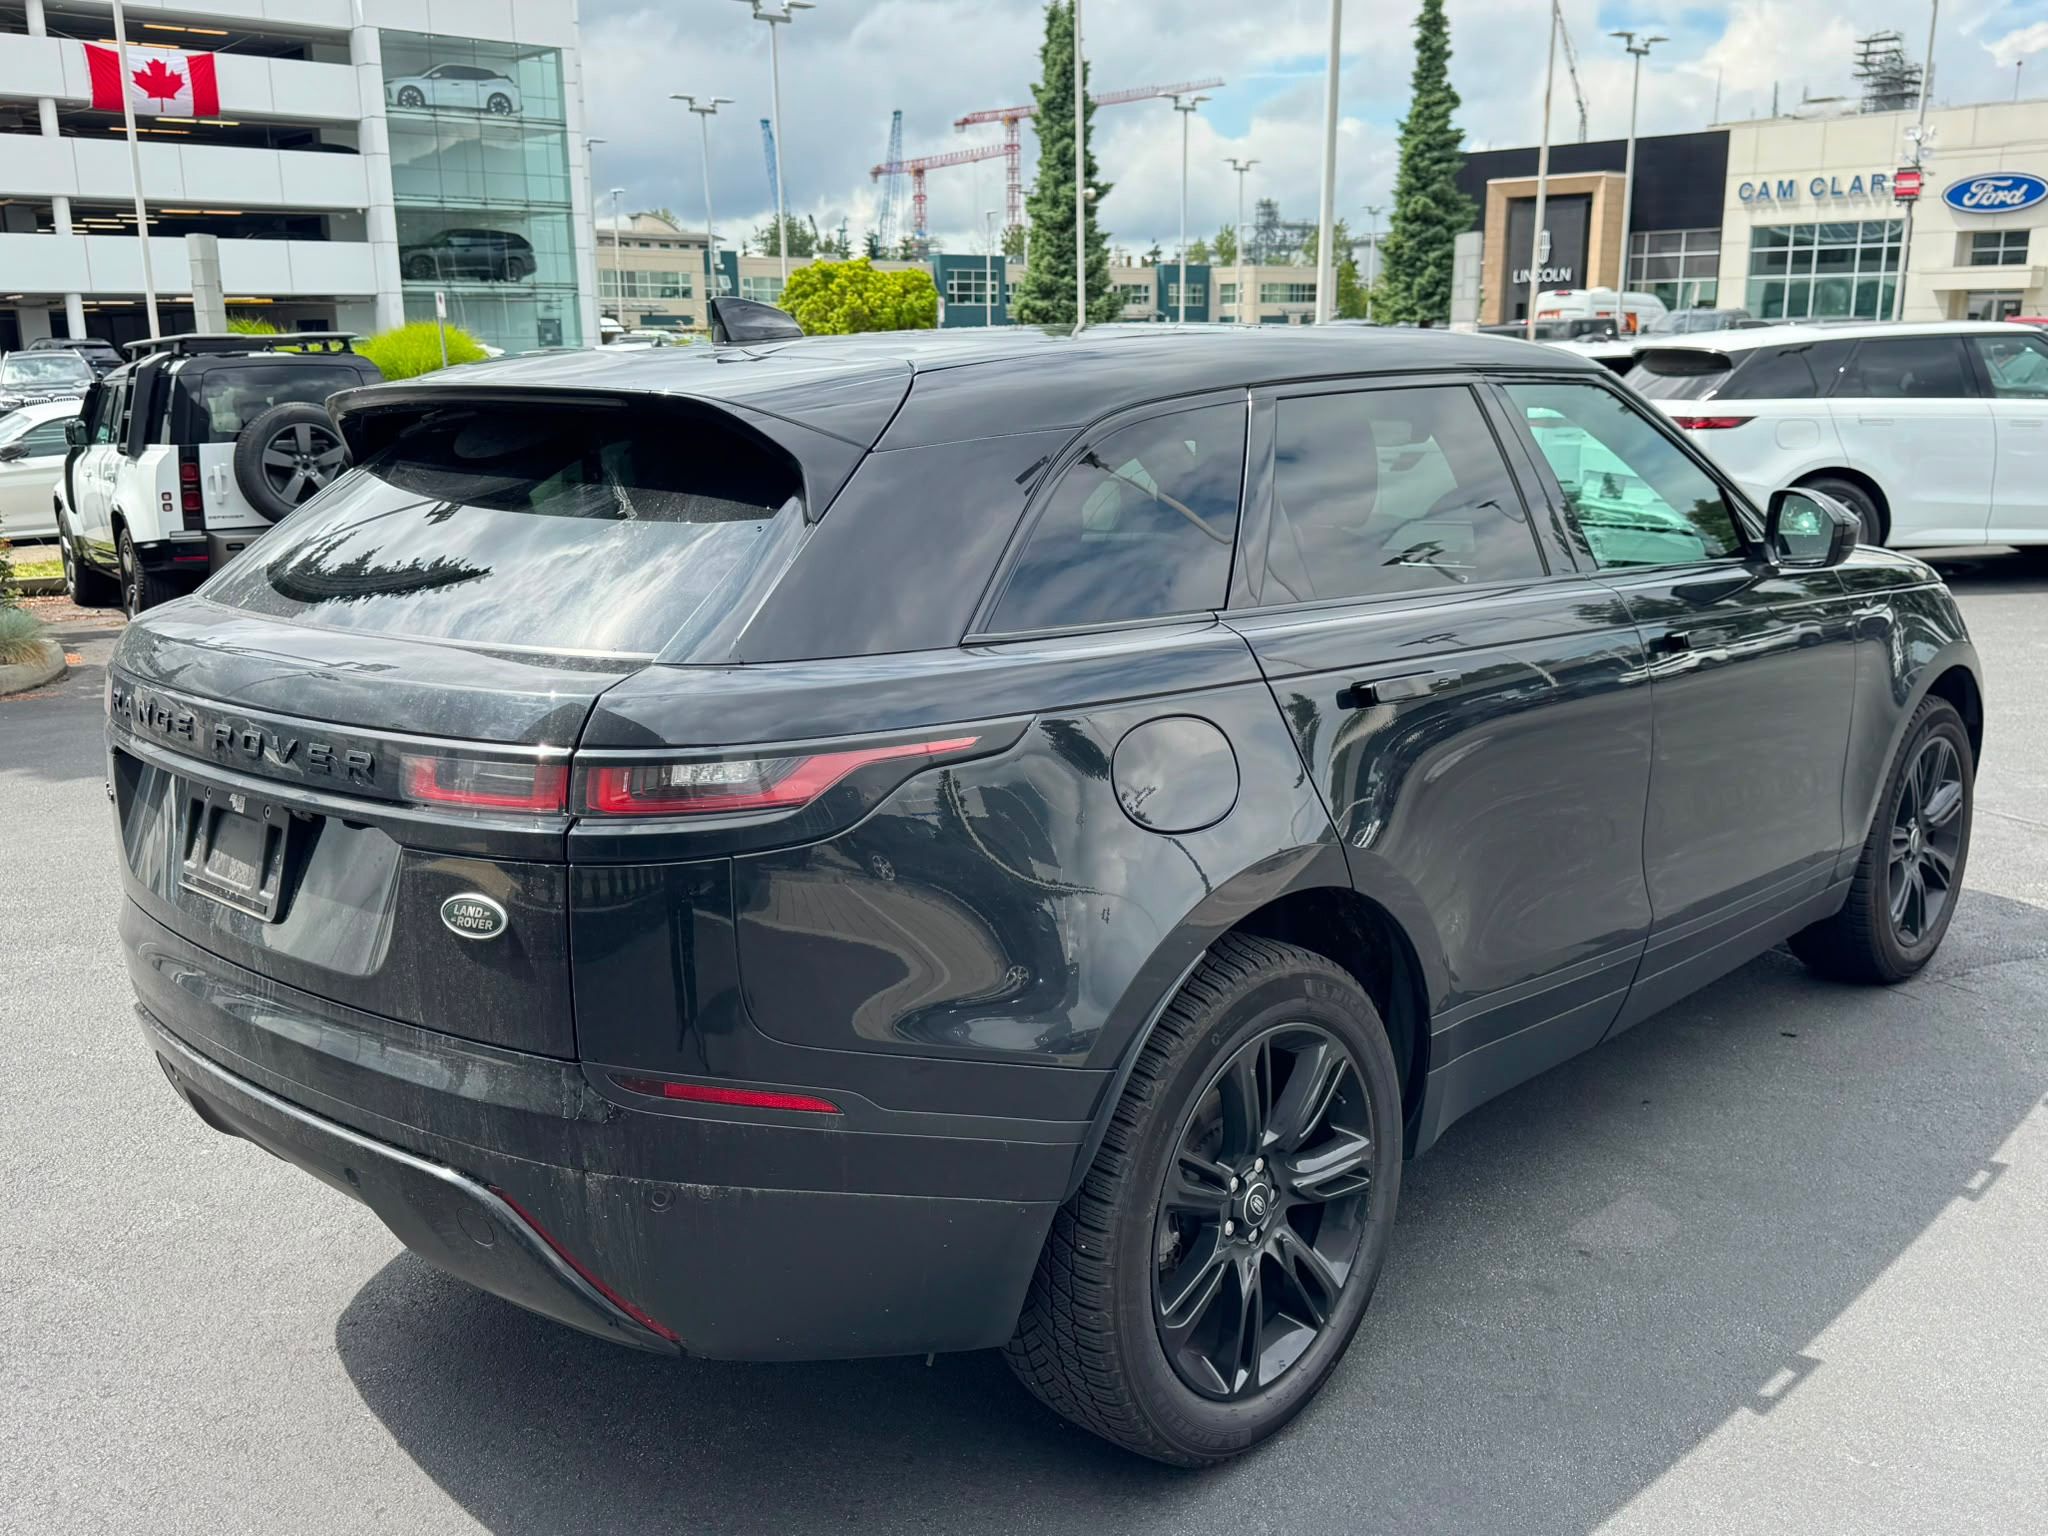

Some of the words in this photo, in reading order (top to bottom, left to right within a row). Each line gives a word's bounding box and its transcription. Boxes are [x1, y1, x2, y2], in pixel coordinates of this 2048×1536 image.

[1738, 180, 1795, 201] CAM
[1809, 173, 1890, 197] CLAR
[1962, 179, 2029, 207] Ford
[111, 686, 194, 741] RANGE
[213, 722, 378, 784] ROVER
[453, 904, 484, 918] LAND
[456, 916, 493, 931] ROVER
